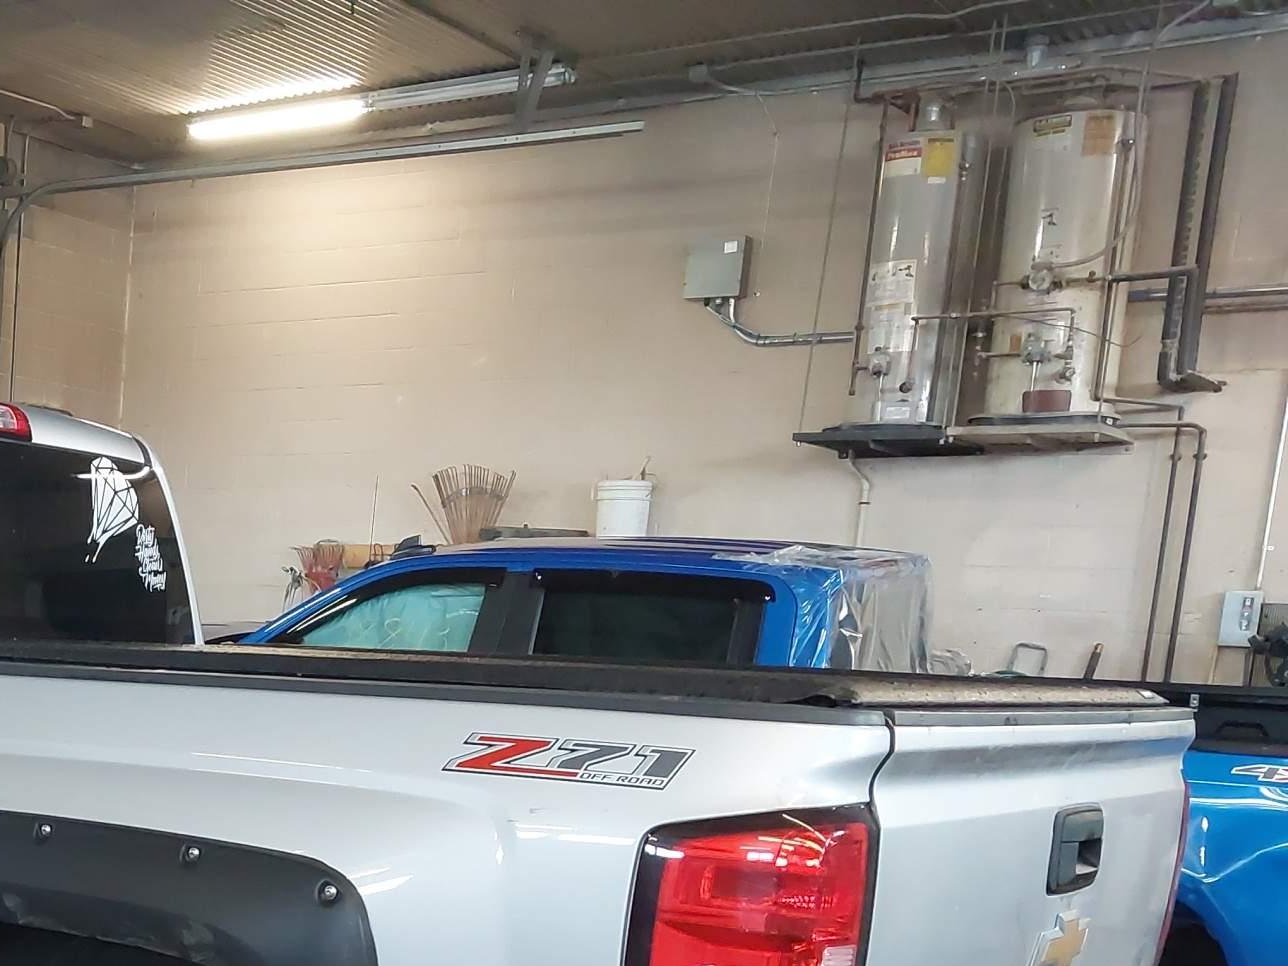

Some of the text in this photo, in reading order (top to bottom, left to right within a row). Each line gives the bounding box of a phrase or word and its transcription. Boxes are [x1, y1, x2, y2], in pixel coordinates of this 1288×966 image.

[442, 732, 696, 789] Z71
[580, 772, 665, 787] OFF ROAD
